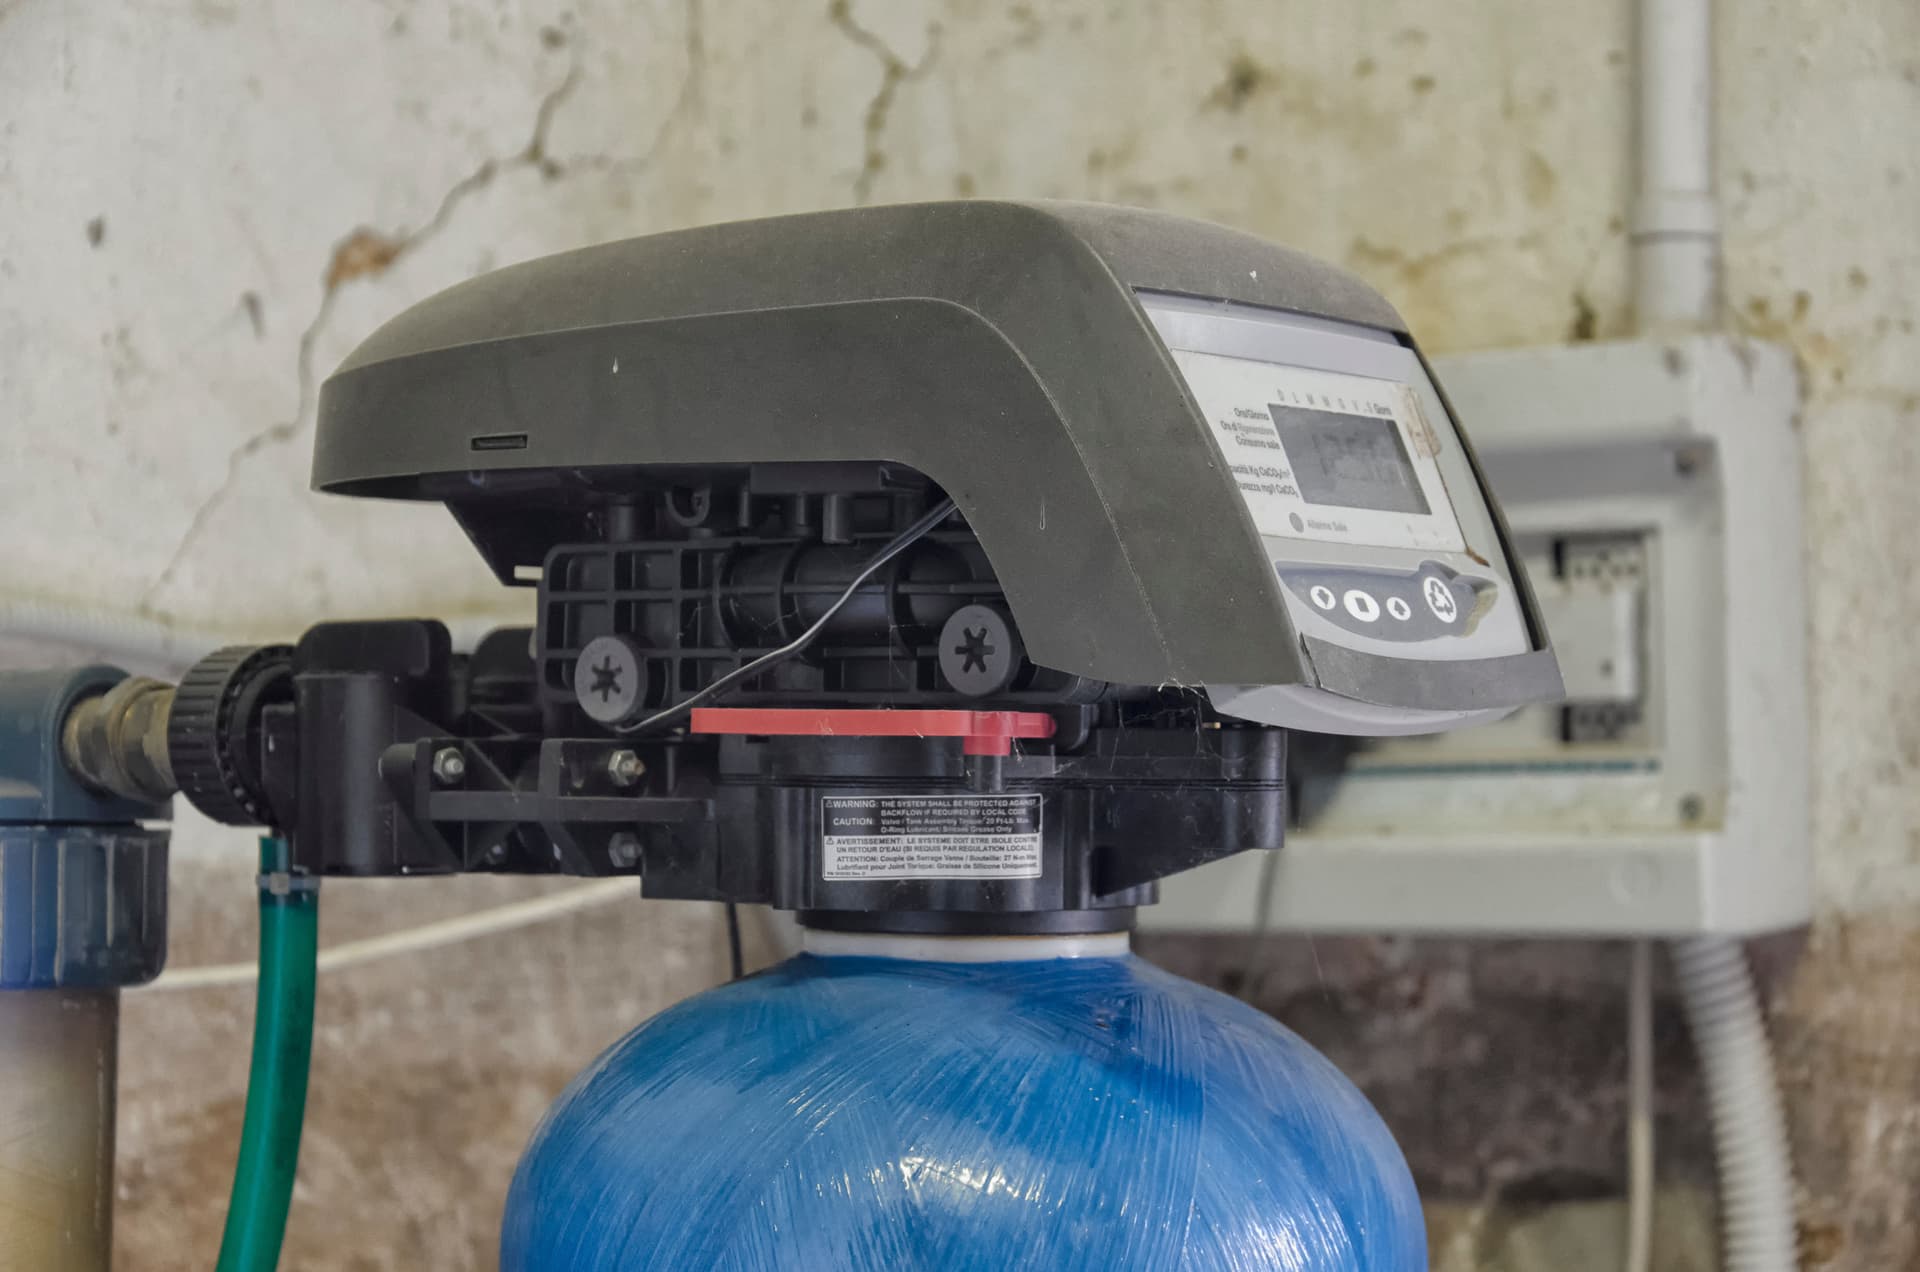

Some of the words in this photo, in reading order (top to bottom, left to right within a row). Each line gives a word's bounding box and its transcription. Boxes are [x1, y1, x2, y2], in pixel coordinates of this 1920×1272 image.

[1235, 435, 1267, 448] Consumo
[1240, 482, 1261, 492] urezza
[833, 800, 879, 809] WARNING:
[881, 800, 896, 808] THE
[897, 800, 927, 808] SYSTEM
[881, 809, 922, 817] BACKFLOW
[881, 826, 905, 834] O-Ring
[996, 826, 1012, 834] Only
[880, 855, 904, 863] Couple
[916, 855, 942, 863] Serrage
[973, 862, 1000, 870] Silicone
